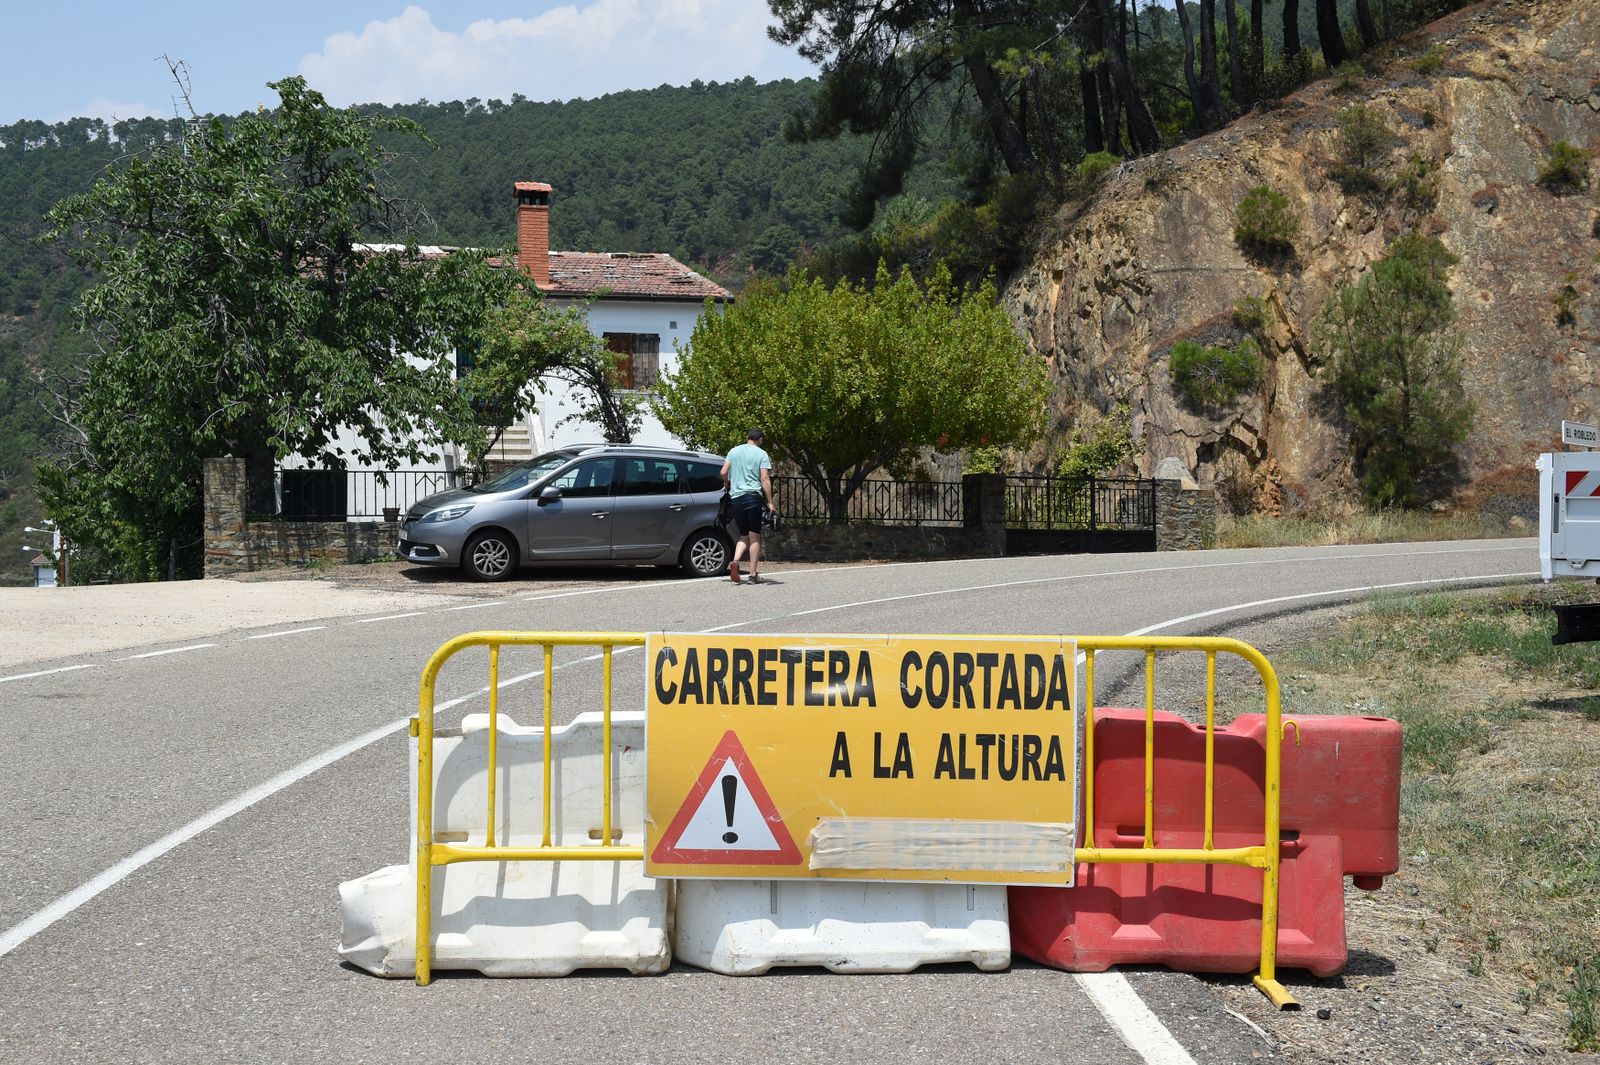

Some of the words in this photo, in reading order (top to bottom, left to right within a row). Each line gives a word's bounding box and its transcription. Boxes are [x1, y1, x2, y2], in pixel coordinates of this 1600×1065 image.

[1566, 428, 1572, 438] EL
[1574, 429, 1596, 441] ROBLEDO
[655, 647, 876, 707] CARRETERA
[900, 650, 1071, 710] CORTADA
[829, 731, 852, 778] A
[874, 731, 914, 779] LA
[934, 733, 1066, 781] ALTURA
